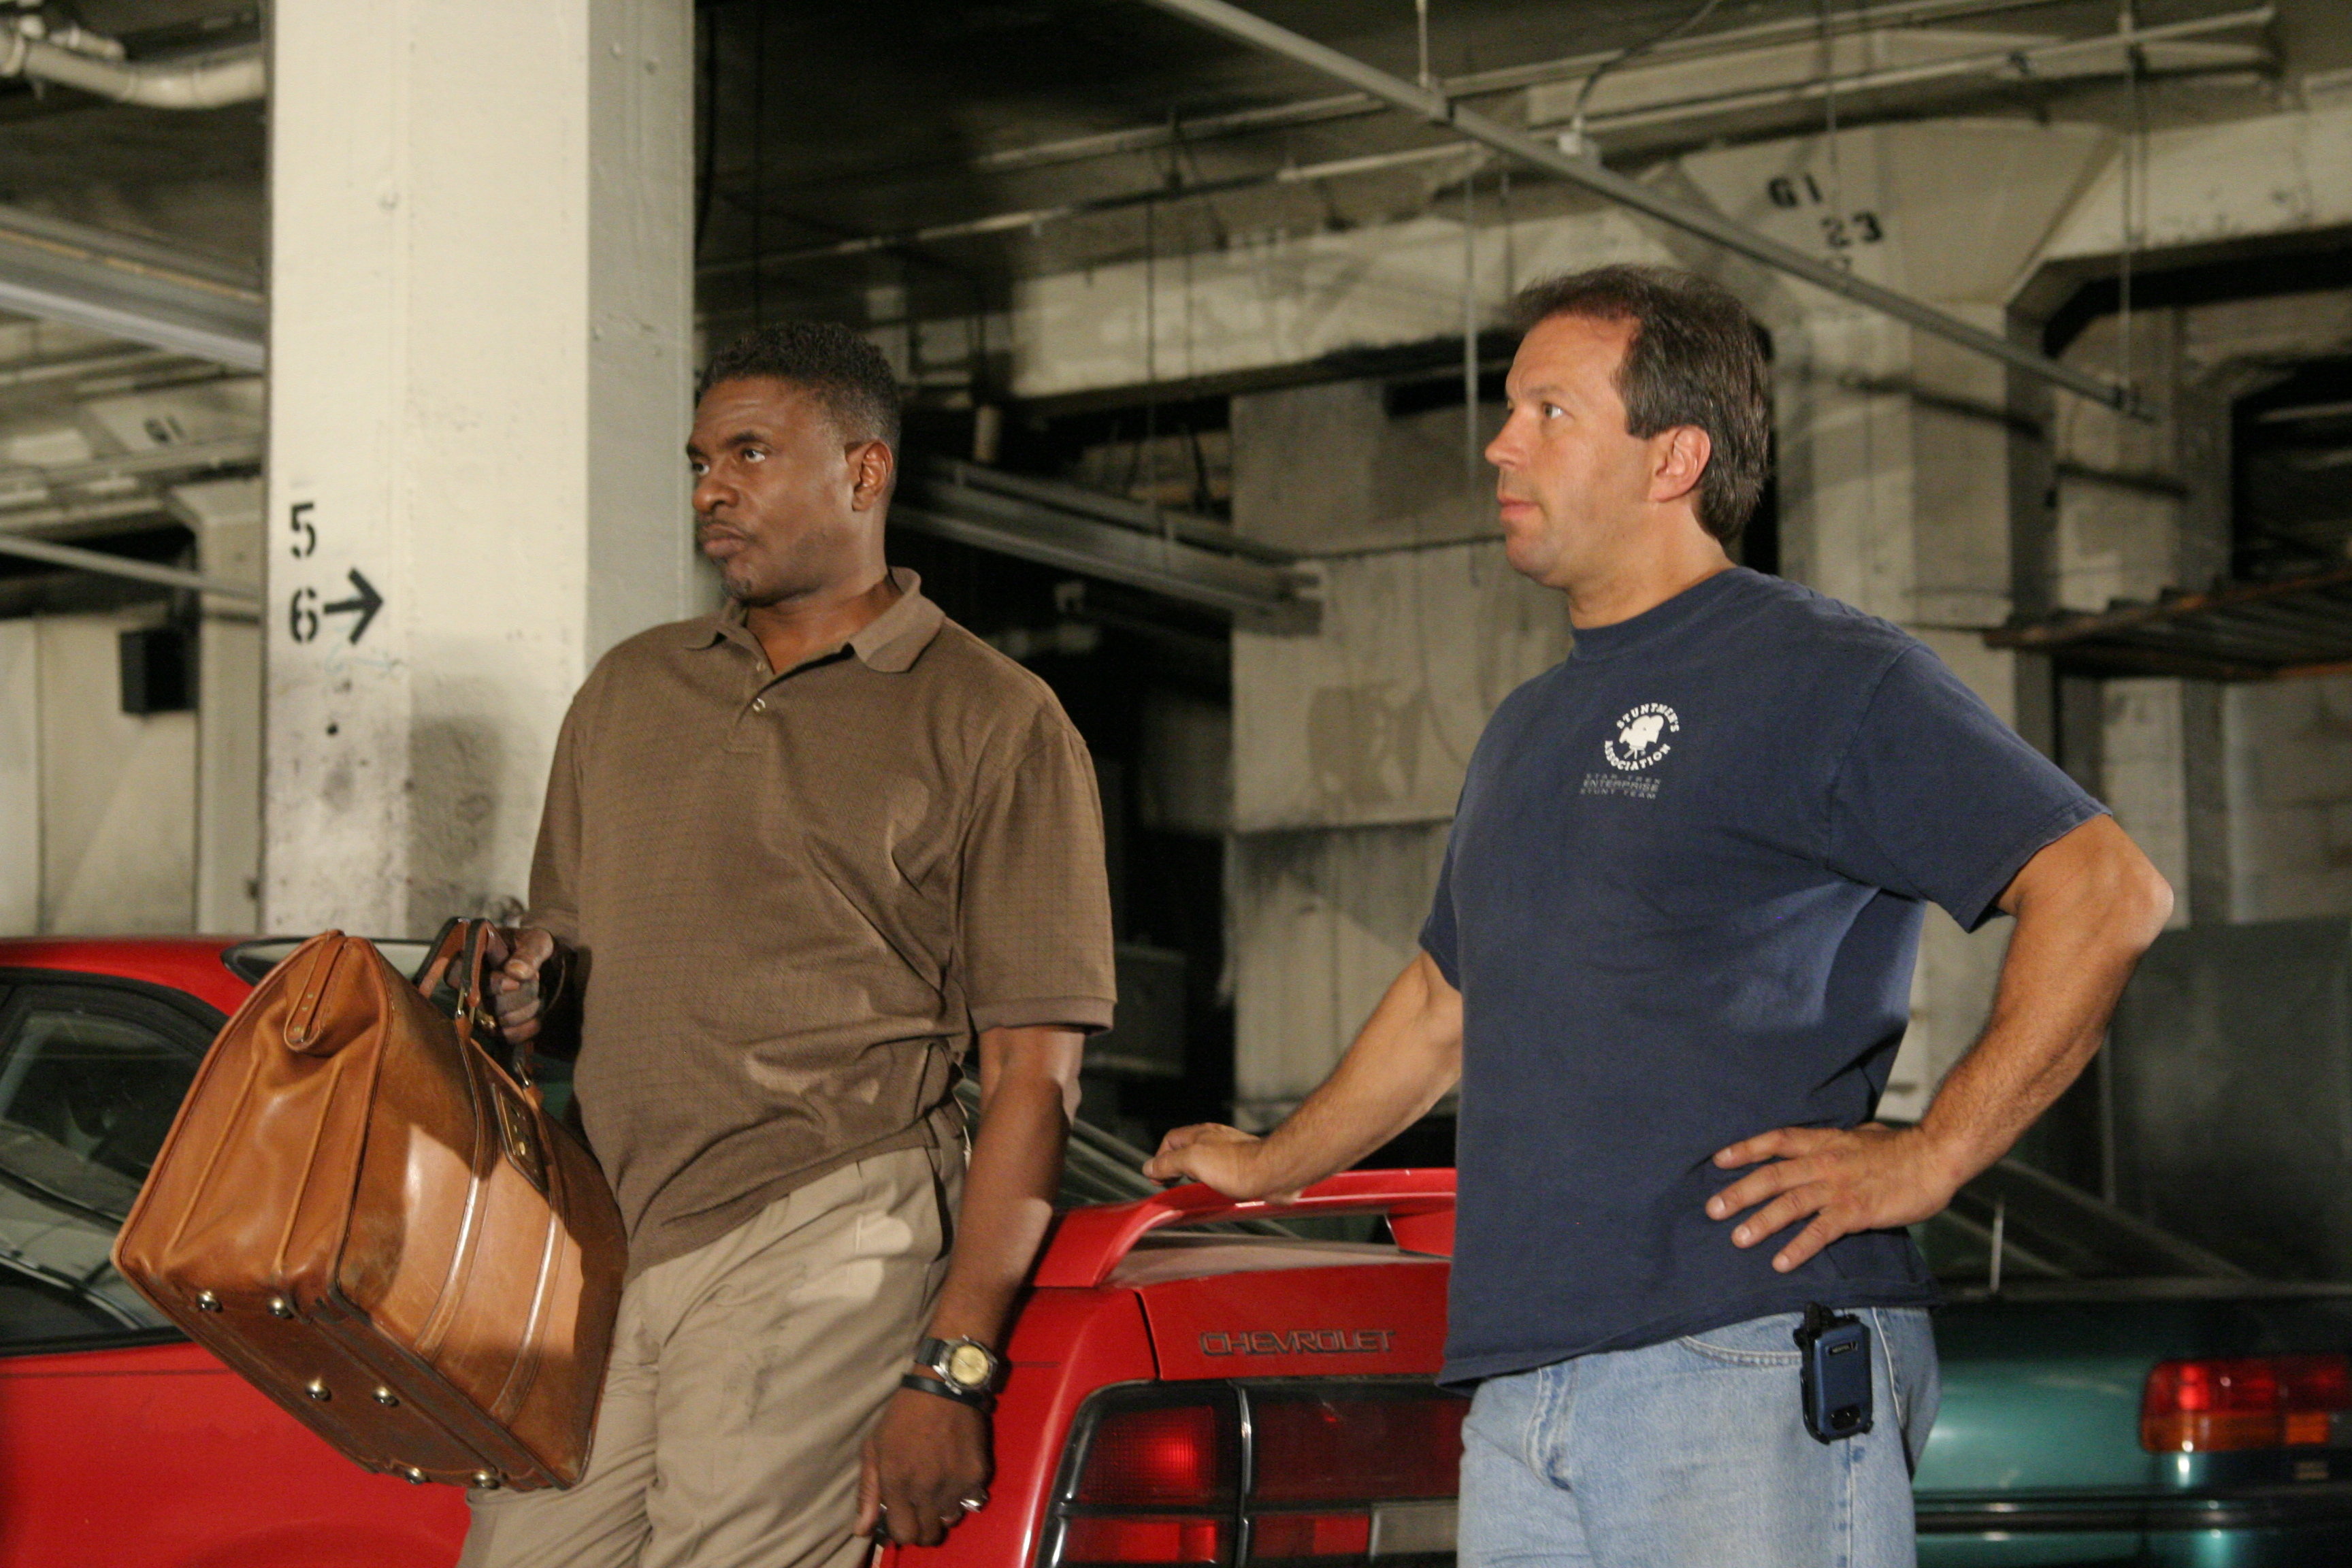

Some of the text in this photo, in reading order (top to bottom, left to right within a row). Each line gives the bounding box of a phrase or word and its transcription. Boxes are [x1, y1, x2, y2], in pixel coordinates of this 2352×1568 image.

[1820, 212, 1883, 248] 23
[291, 502, 316, 559] 5
[290, 587, 318, 642] 6
[1200, 1329, 1396, 1356] CHEVROLET
